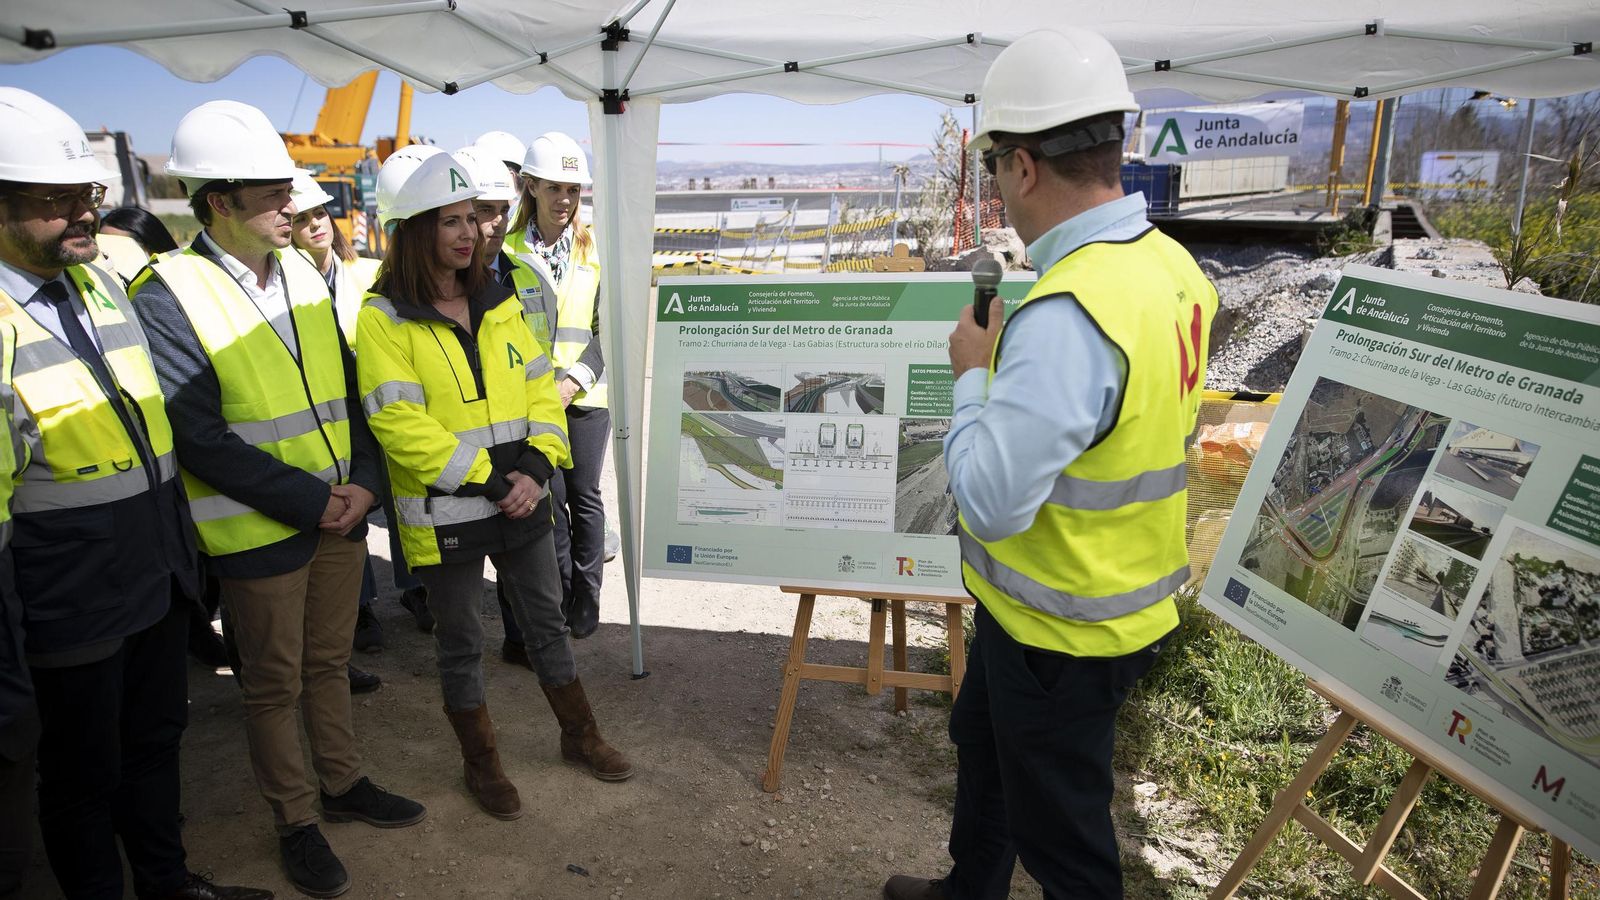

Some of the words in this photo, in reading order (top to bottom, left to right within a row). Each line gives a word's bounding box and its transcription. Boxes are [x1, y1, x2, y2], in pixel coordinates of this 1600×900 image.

[1195, 118, 1240, 132] Junta
[1194, 136, 1213, 149] de
[1217, 128, 1298, 148] Andalucía
[688, 294, 711, 303] Junta
[748, 290, 778, 299] Consejería
[779, 290, 787, 298] de
[787, 290, 815, 299] Fomento,
[1361, 294, 1386, 307] Junta
[687, 303, 698, 312] de
[698, 301, 739, 312] Andalucía
[747, 298, 782, 306] Articulación
[1356, 305, 1367, 315] de
[1367, 308, 1410, 325] Andalucía
[1427, 303, 1461, 317] Consejería
[1461, 310, 1471, 319] de
[1471, 312, 1504, 327] Fomento,
[680, 324, 749, 337] Prolongación
[752, 325, 771, 335] Sur
[773, 325, 790, 335] del
[793, 325, 825, 335] Metro
[828, 325, 841, 335] de
[844, 325, 893, 335] Granada
[1416, 323, 1422, 331] y
[1422, 323, 1450, 336] Vivienda
[1421, 313, 1460, 328] Articulación
[1461, 321, 1473, 331] del
[1473, 323, 1507, 338] Territorio
[678, 340, 702, 348] Tramo
[711, 339, 748, 348] Churriana
[749, 339, 759, 348] de
[760, 340, 767, 348] la
[768, 340, 787, 349] Vega
[793, 340, 806, 348] Las
[807, 340, 834, 348] Gabias
[835, 340, 879, 349] (Estructura
[880, 340, 903, 349] sobre
[905, 341, 912, 349] el
[1549, 336, 1559, 345] de
[1336, 329, 1408, 358] Prolongación
[1409, 348, 1431, 363] Sur
[1432, 354, 1455, 370] del
[1453, 359, 1495, 381] Metro
[1496, 371, 1515, 386] de
[1518, 376, 1584, 405] Granada
[1328, 345, 1352, 360] Tramo
[1352, 352, 1360, 362] 2:
[1360, 354, 1398, 373] Churriana
[1399, 366, 1410, 377] de
[1410, 367, 1419, 379] la
[1420, 371, 1441, 387] Vega
[1446, 379, 1463, 392] Las
[1464, 384, 1496, 401] Gabias
[1496, 392, 1533, 412] (futuro
[1251, 590, 1276, 609] Financiado
[1275, 607, 1286, 615] por
[1253, 600, 1267, 613] Unión
[1266, 609, 1287, 626] Europea
